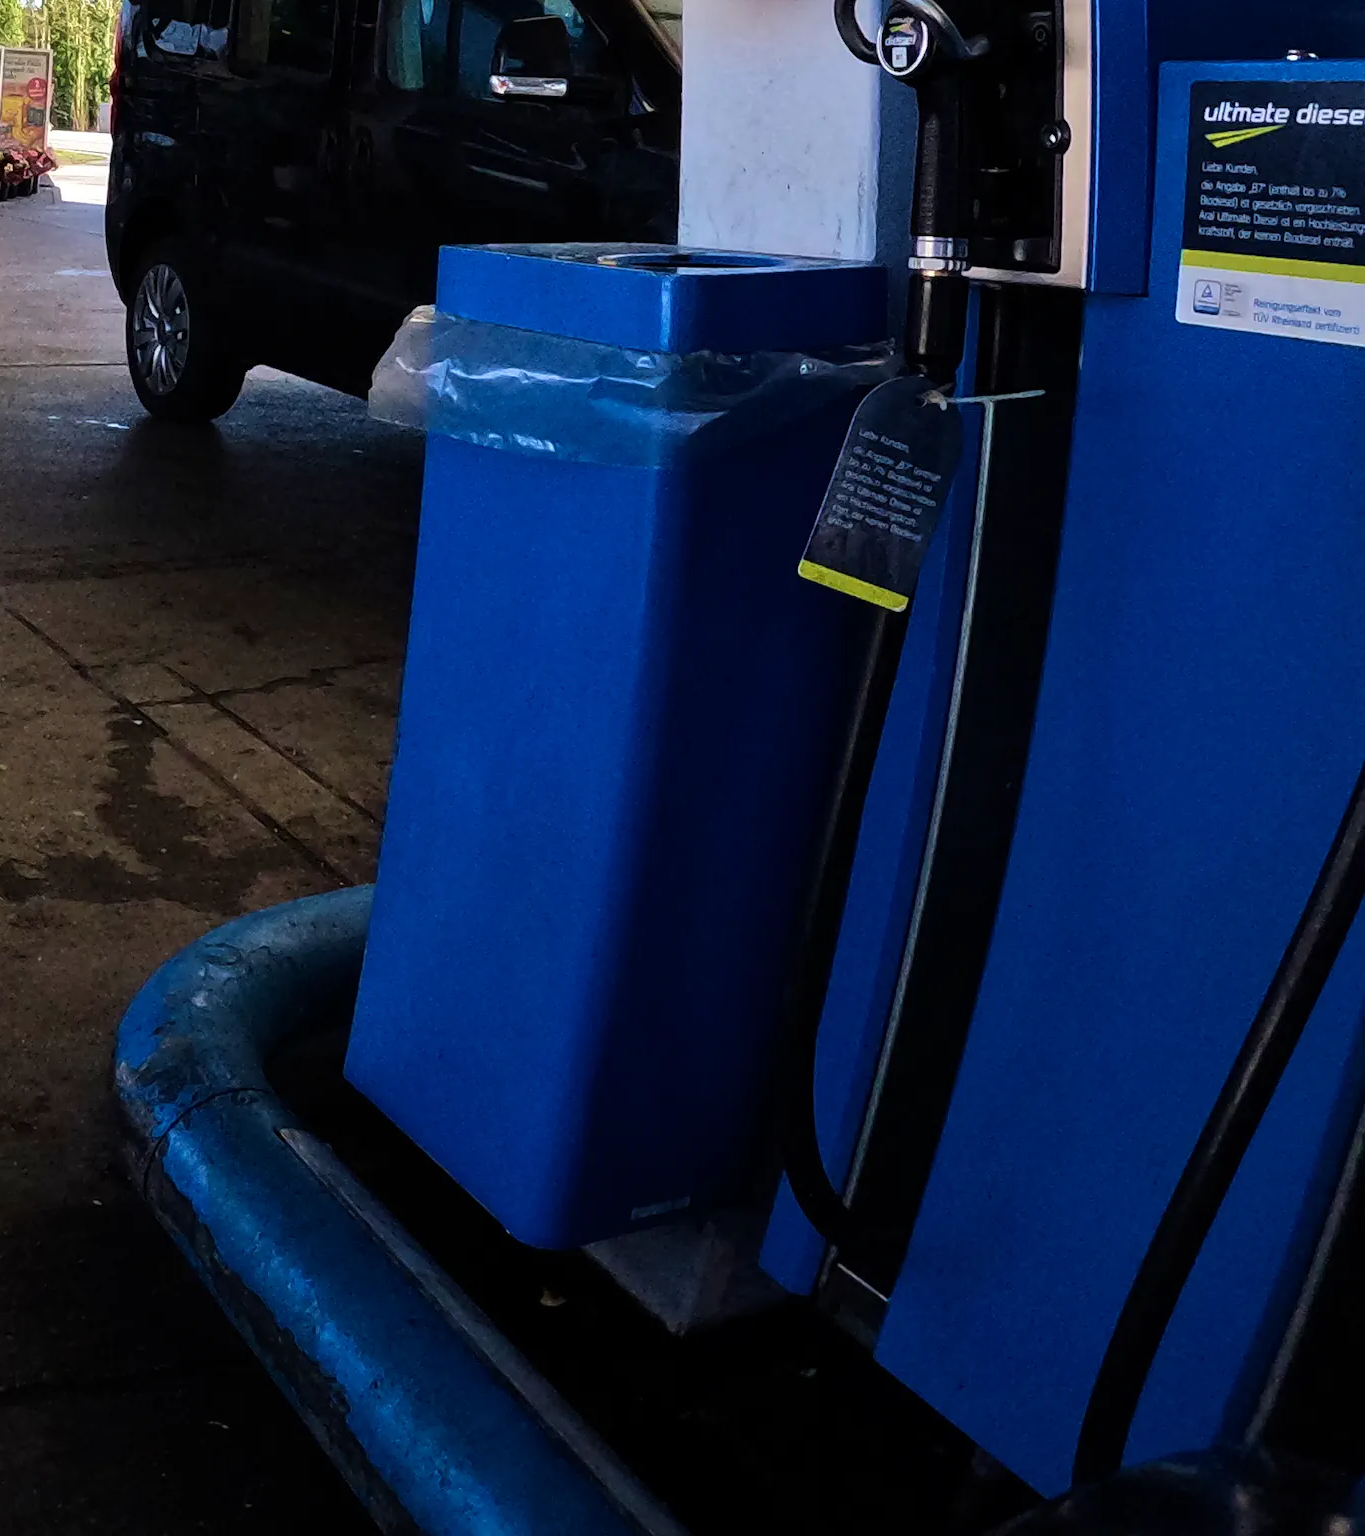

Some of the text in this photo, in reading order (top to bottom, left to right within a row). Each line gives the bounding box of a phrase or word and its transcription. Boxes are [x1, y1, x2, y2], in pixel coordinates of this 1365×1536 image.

[1204, 102, 1365, 126] ultimate diese
[1253, 312, 1269, 324] TÜV
